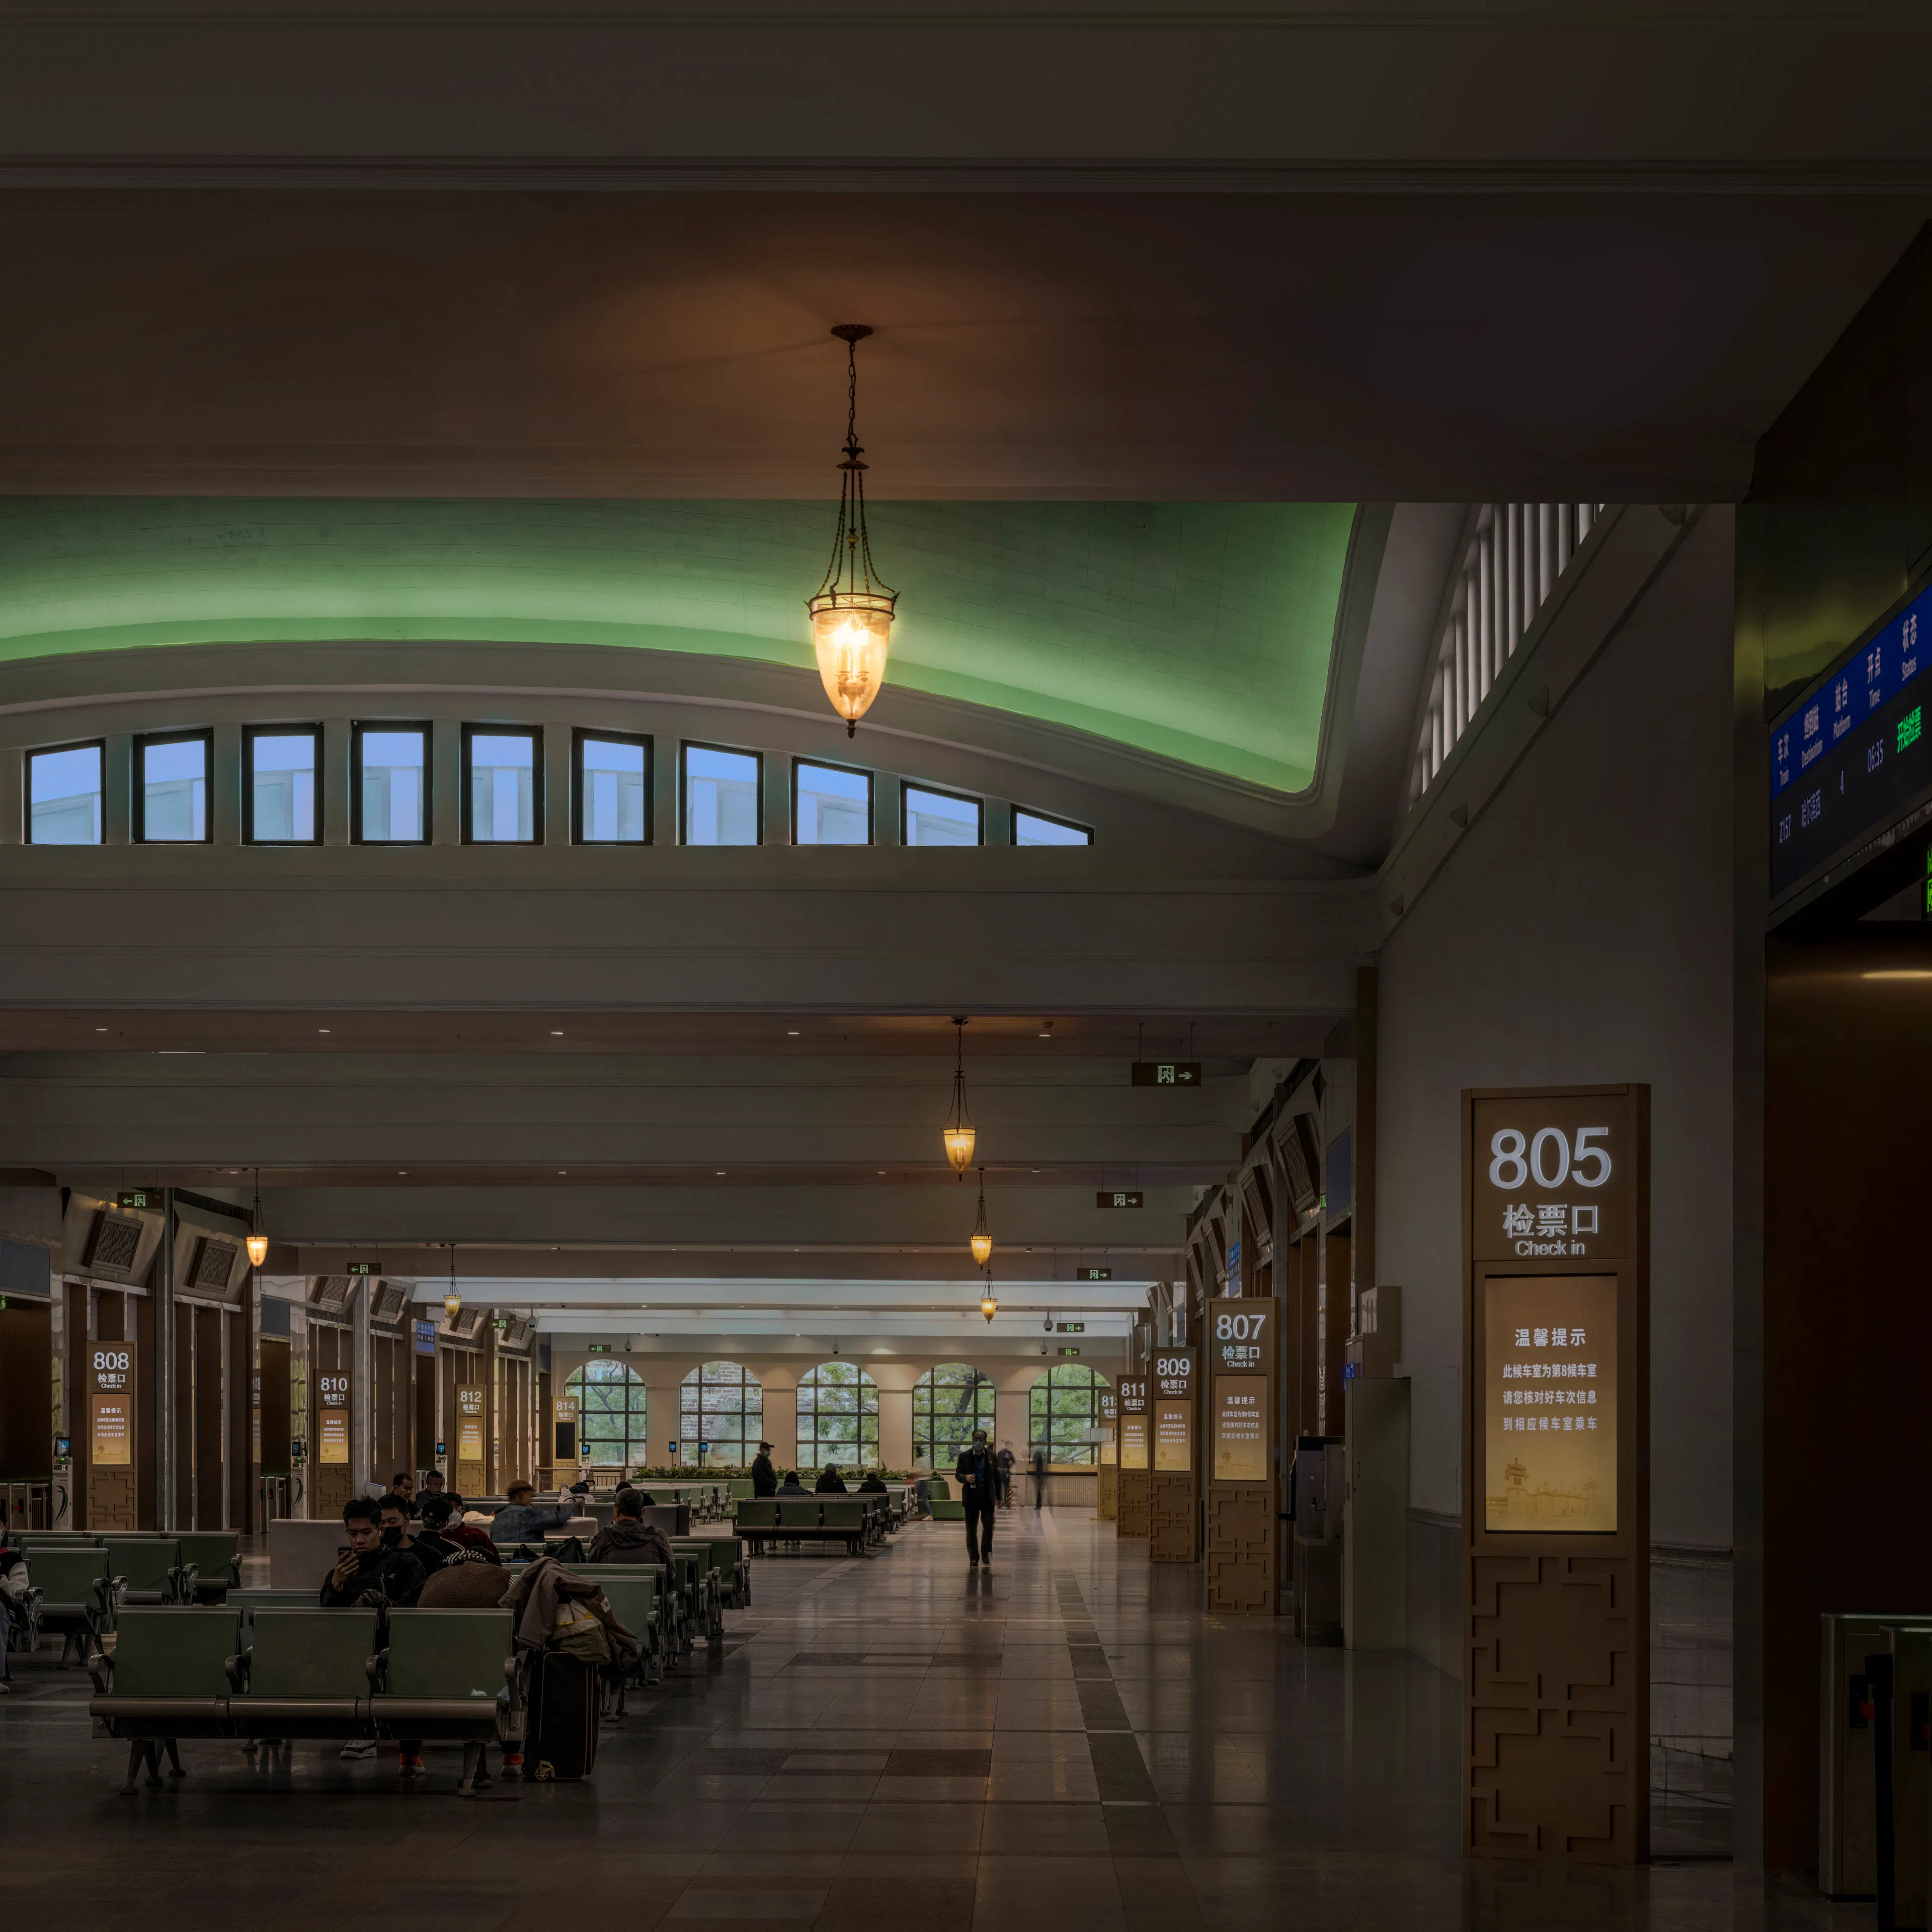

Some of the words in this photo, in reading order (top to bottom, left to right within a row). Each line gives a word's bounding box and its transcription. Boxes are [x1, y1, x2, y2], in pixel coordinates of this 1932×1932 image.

[1777, 732, 1790, 764] 车次
[1835, 678, 1848, 713] 站台
[1867, 646, 1881, 685] 开点
[1902, 613, 1917, 654] 状态
[1779, 765, 1790, 787] Train
[1801, 738, 1823, 768] Destination
[1833, 714, 1852, 741] Platform
[1869, 688, 1881, 710] Time
[1901, 656, 1917, 682] Status
[1839, 771, 1844, 794] 4
[1867, 738, 1884, 773] 06:35
[1897, 705, 1922, 754] 开始检票
[1489, 1126, 1612, 1189] 805
[1502, 1203, 1598, 1238] 检票口
[1515, 1240, 1567, 1256] Check
[1571, 1239, 1585, 1255] in
[1217, 1314, 1266, 1340] 807
[1515, 1328, 1586, 1347] 温馨提示
[1222, 1345, 1260, 1360] 检票口
[94, 1352, 129, 1370] 808
[1157, 1358, 1190, 1376] 809
[98, 1373, 126, 1383] 检票口
[1503, 1363, 1596, 1378] 此候车室为第8候车室
[320, 1377, 348, 1391] 810
[1121, 1383, 1145, 1397] 811
[1160, 1379, 1187, 1389] 检票口
[324, 1393, 345, 1401] 检票口
[460, 1391, 481, 1402] 812
[1124, 1399, 1145, 1407] 检票口
[1227, 1396, 1255, 1405] 温馨提示
[1503, 1390, 1597, 1405] 请您核对好车次信息
[556, 1401, 575, 1411] 814
[1503, 1416, 1597, 1431] 到相应候车室乘车
